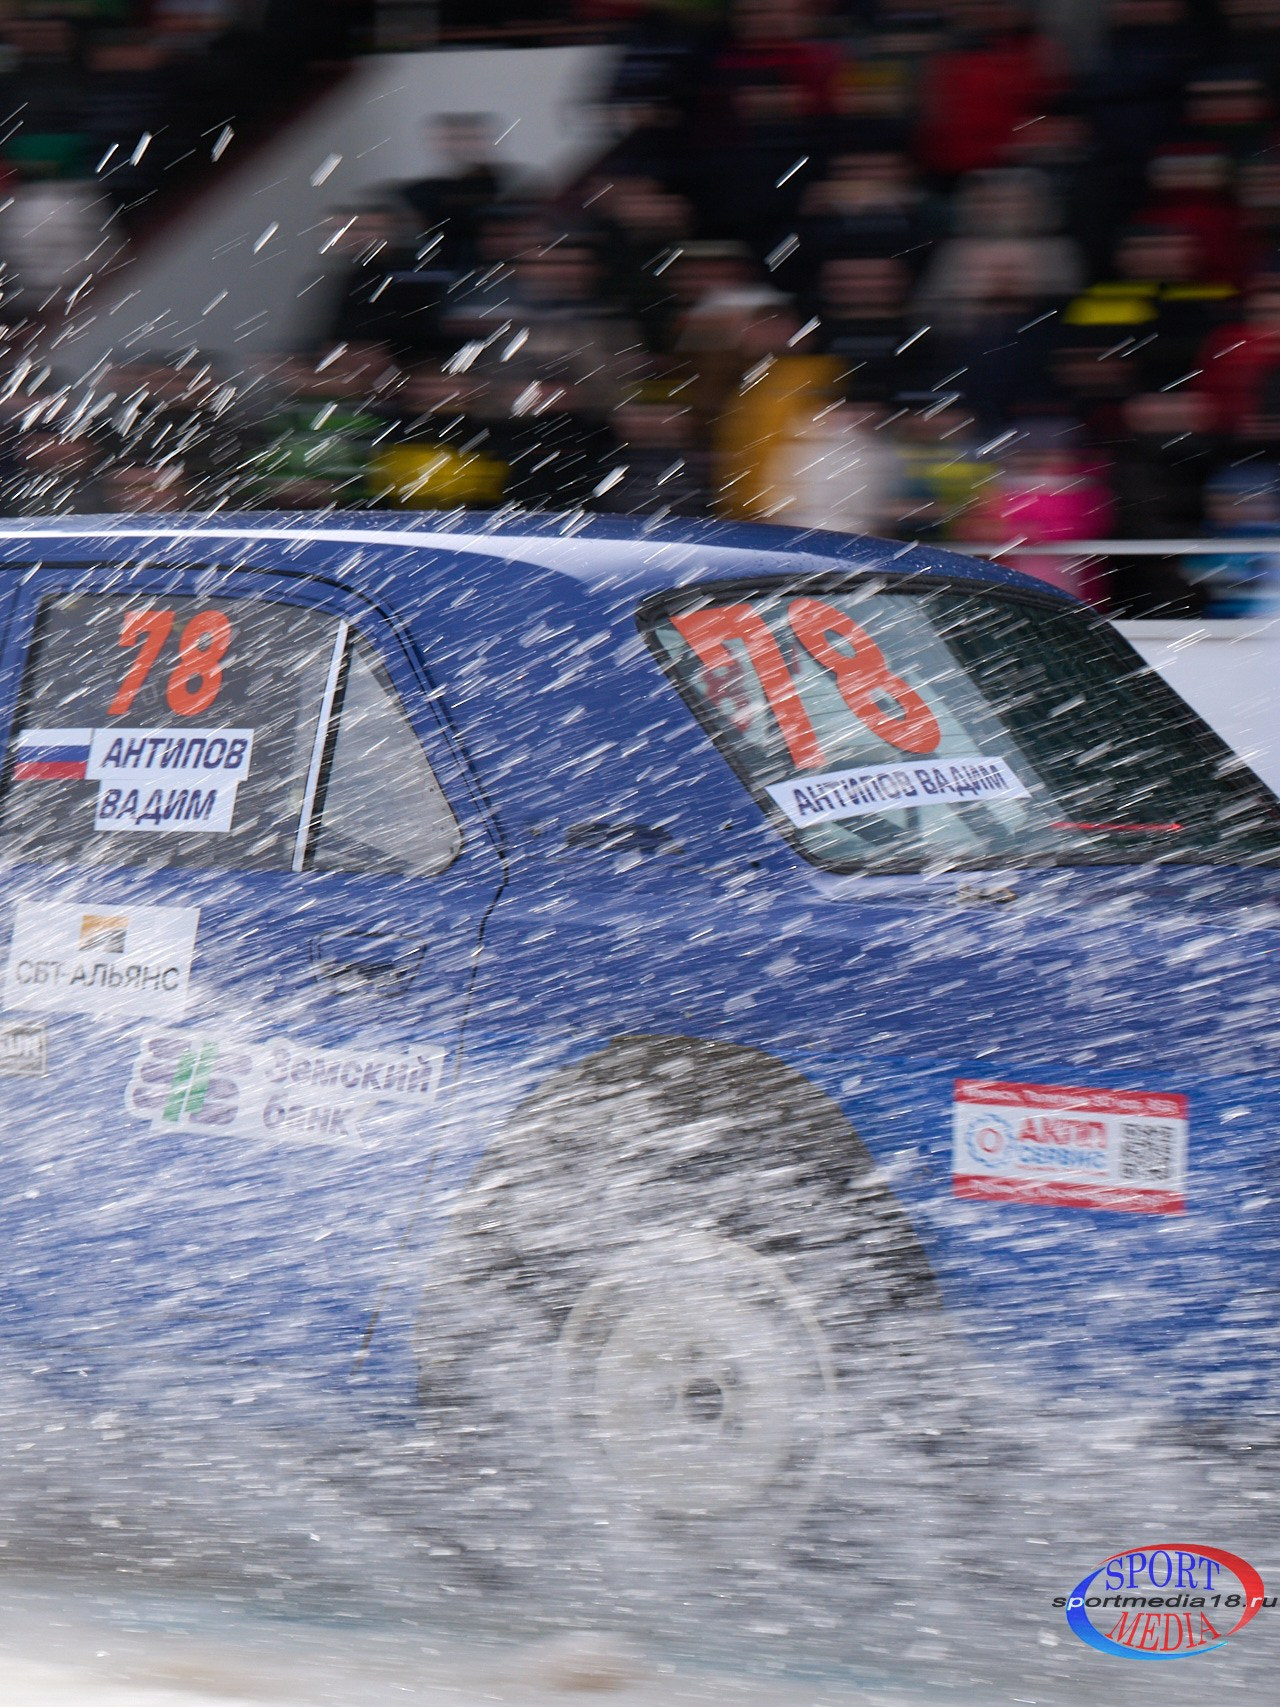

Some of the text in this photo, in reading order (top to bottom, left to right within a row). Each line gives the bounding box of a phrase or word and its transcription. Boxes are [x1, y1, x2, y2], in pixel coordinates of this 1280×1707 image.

[107, 610, 231, 716] 78
[670, 598, 941, 769] 78
[101, 737, 249, 770] АНТИПОВ
[99, 788, 216, 826] ВАДИМ
[792, 764, 1010, 816] АНТИПОВ ВАДИМ
[16, 960, 180, 991] СБТ-АЛЬЯНС
